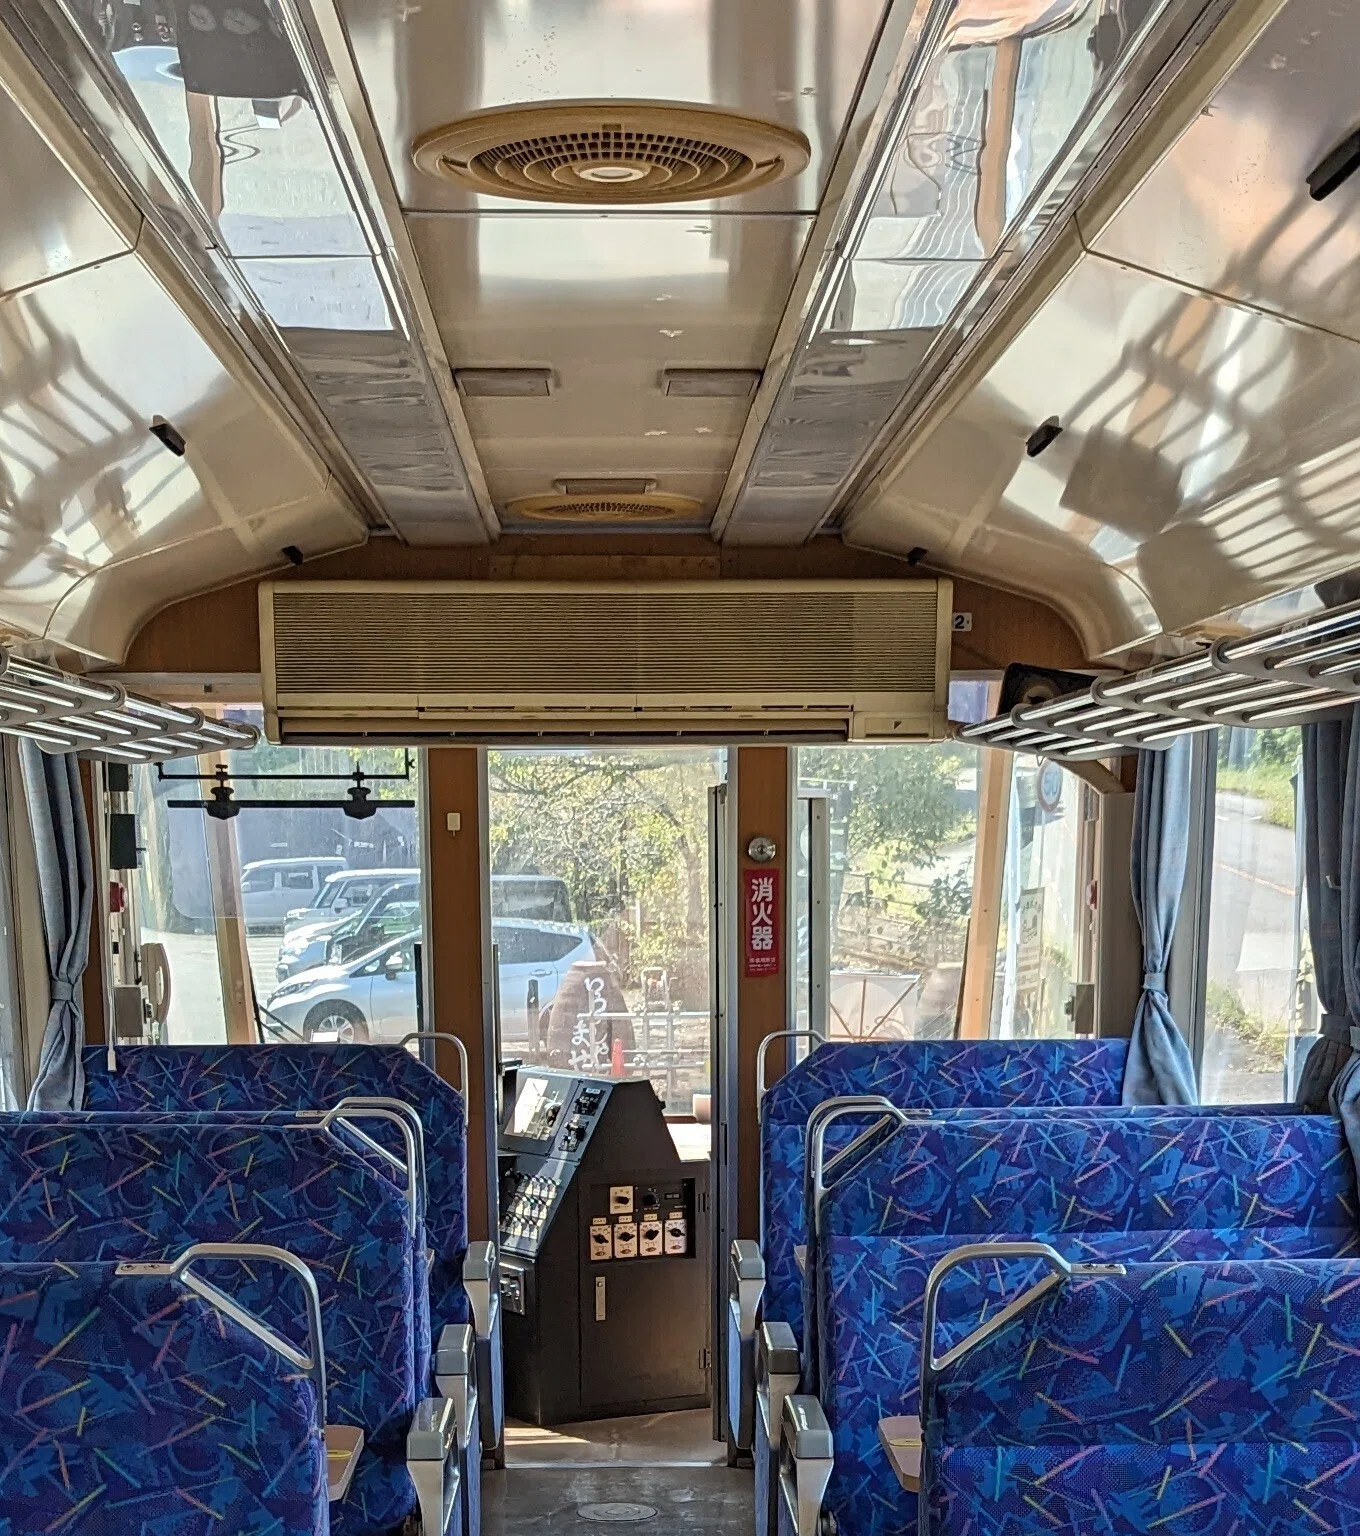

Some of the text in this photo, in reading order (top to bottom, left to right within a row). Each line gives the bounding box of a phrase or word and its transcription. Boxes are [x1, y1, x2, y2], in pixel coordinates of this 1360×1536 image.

[954, 614, 965, 629] 2
[751, 876, 774, 951] 消火器
